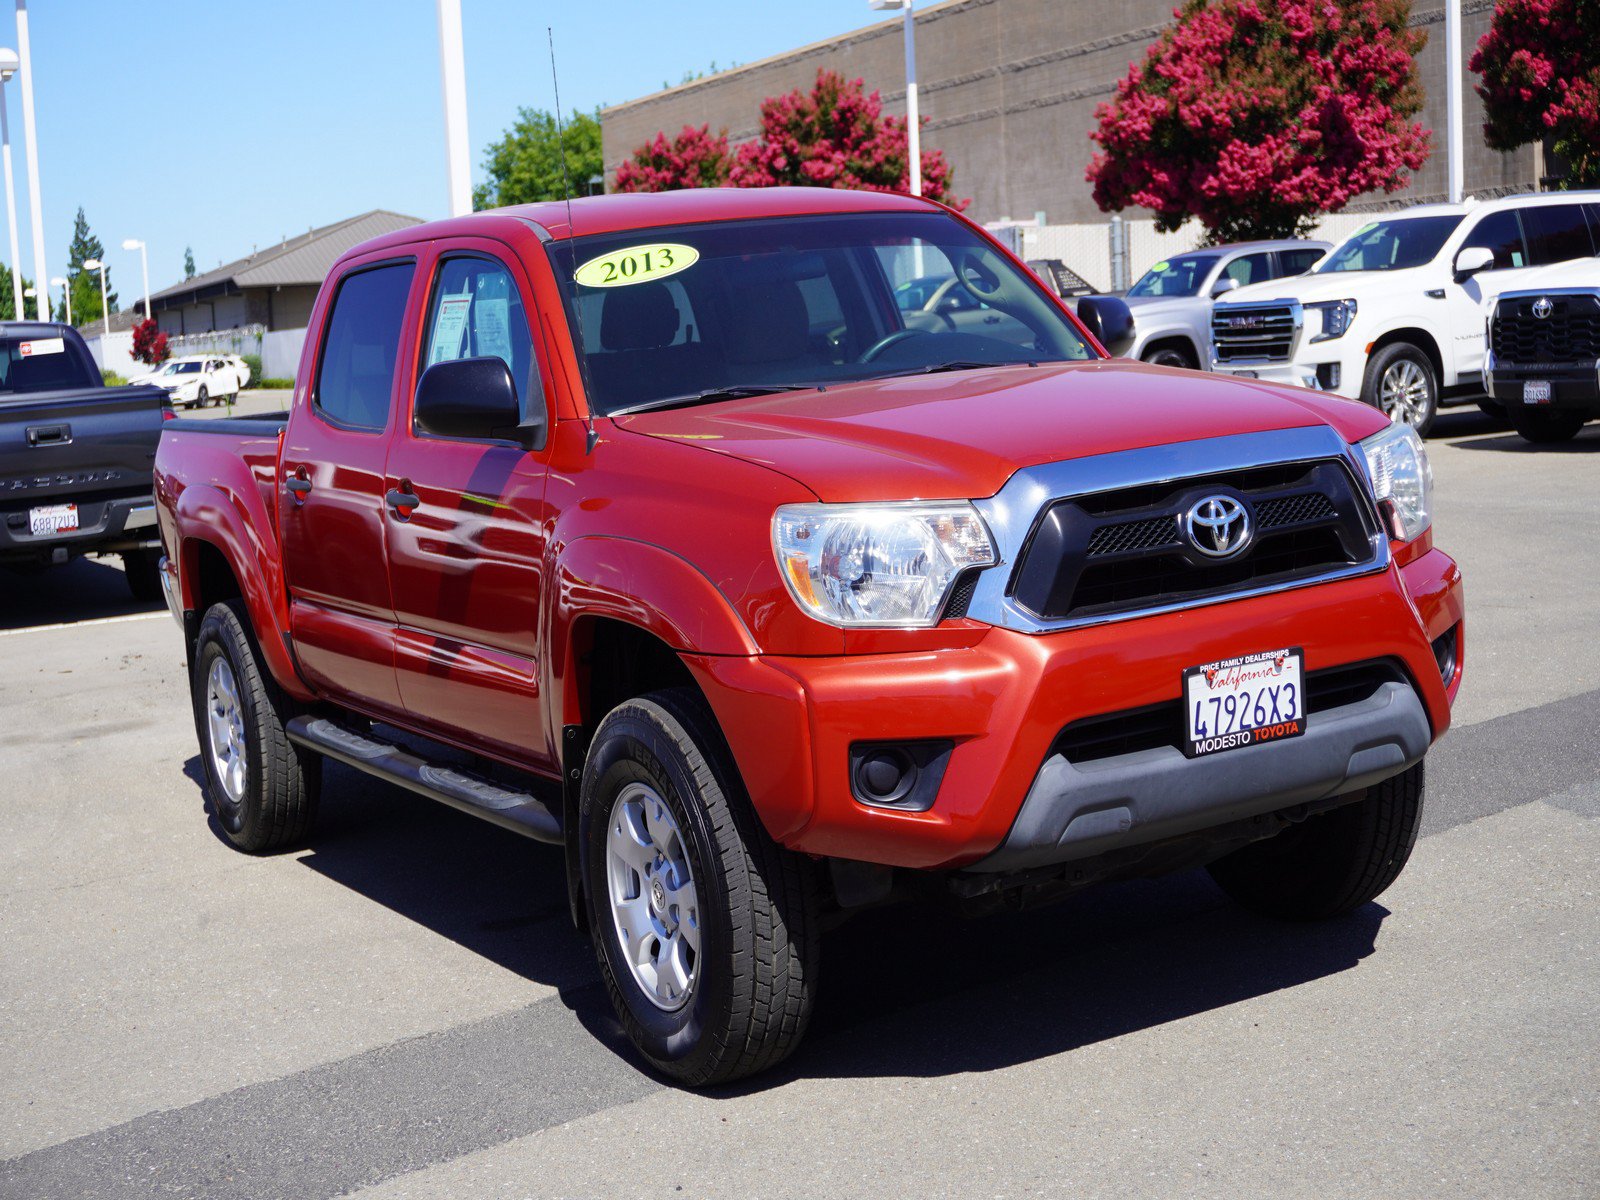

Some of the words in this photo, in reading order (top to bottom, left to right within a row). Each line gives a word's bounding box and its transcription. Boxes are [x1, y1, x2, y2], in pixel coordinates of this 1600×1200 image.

[600, 248, 675, 283] 2013
[1200, 662, 1219, 673] PRICE
[1221, 657, 1244, 669] FAMILY
[1245, 649, 1290, 663] DEALERSHIPS
[1210, 663, 1281, 691] California
[1194, 682, 1297, 739] 47926X3
[1195, 731, 1251, 754] MODESTO
[1253, 721, 1299, 741] TOYOTA
